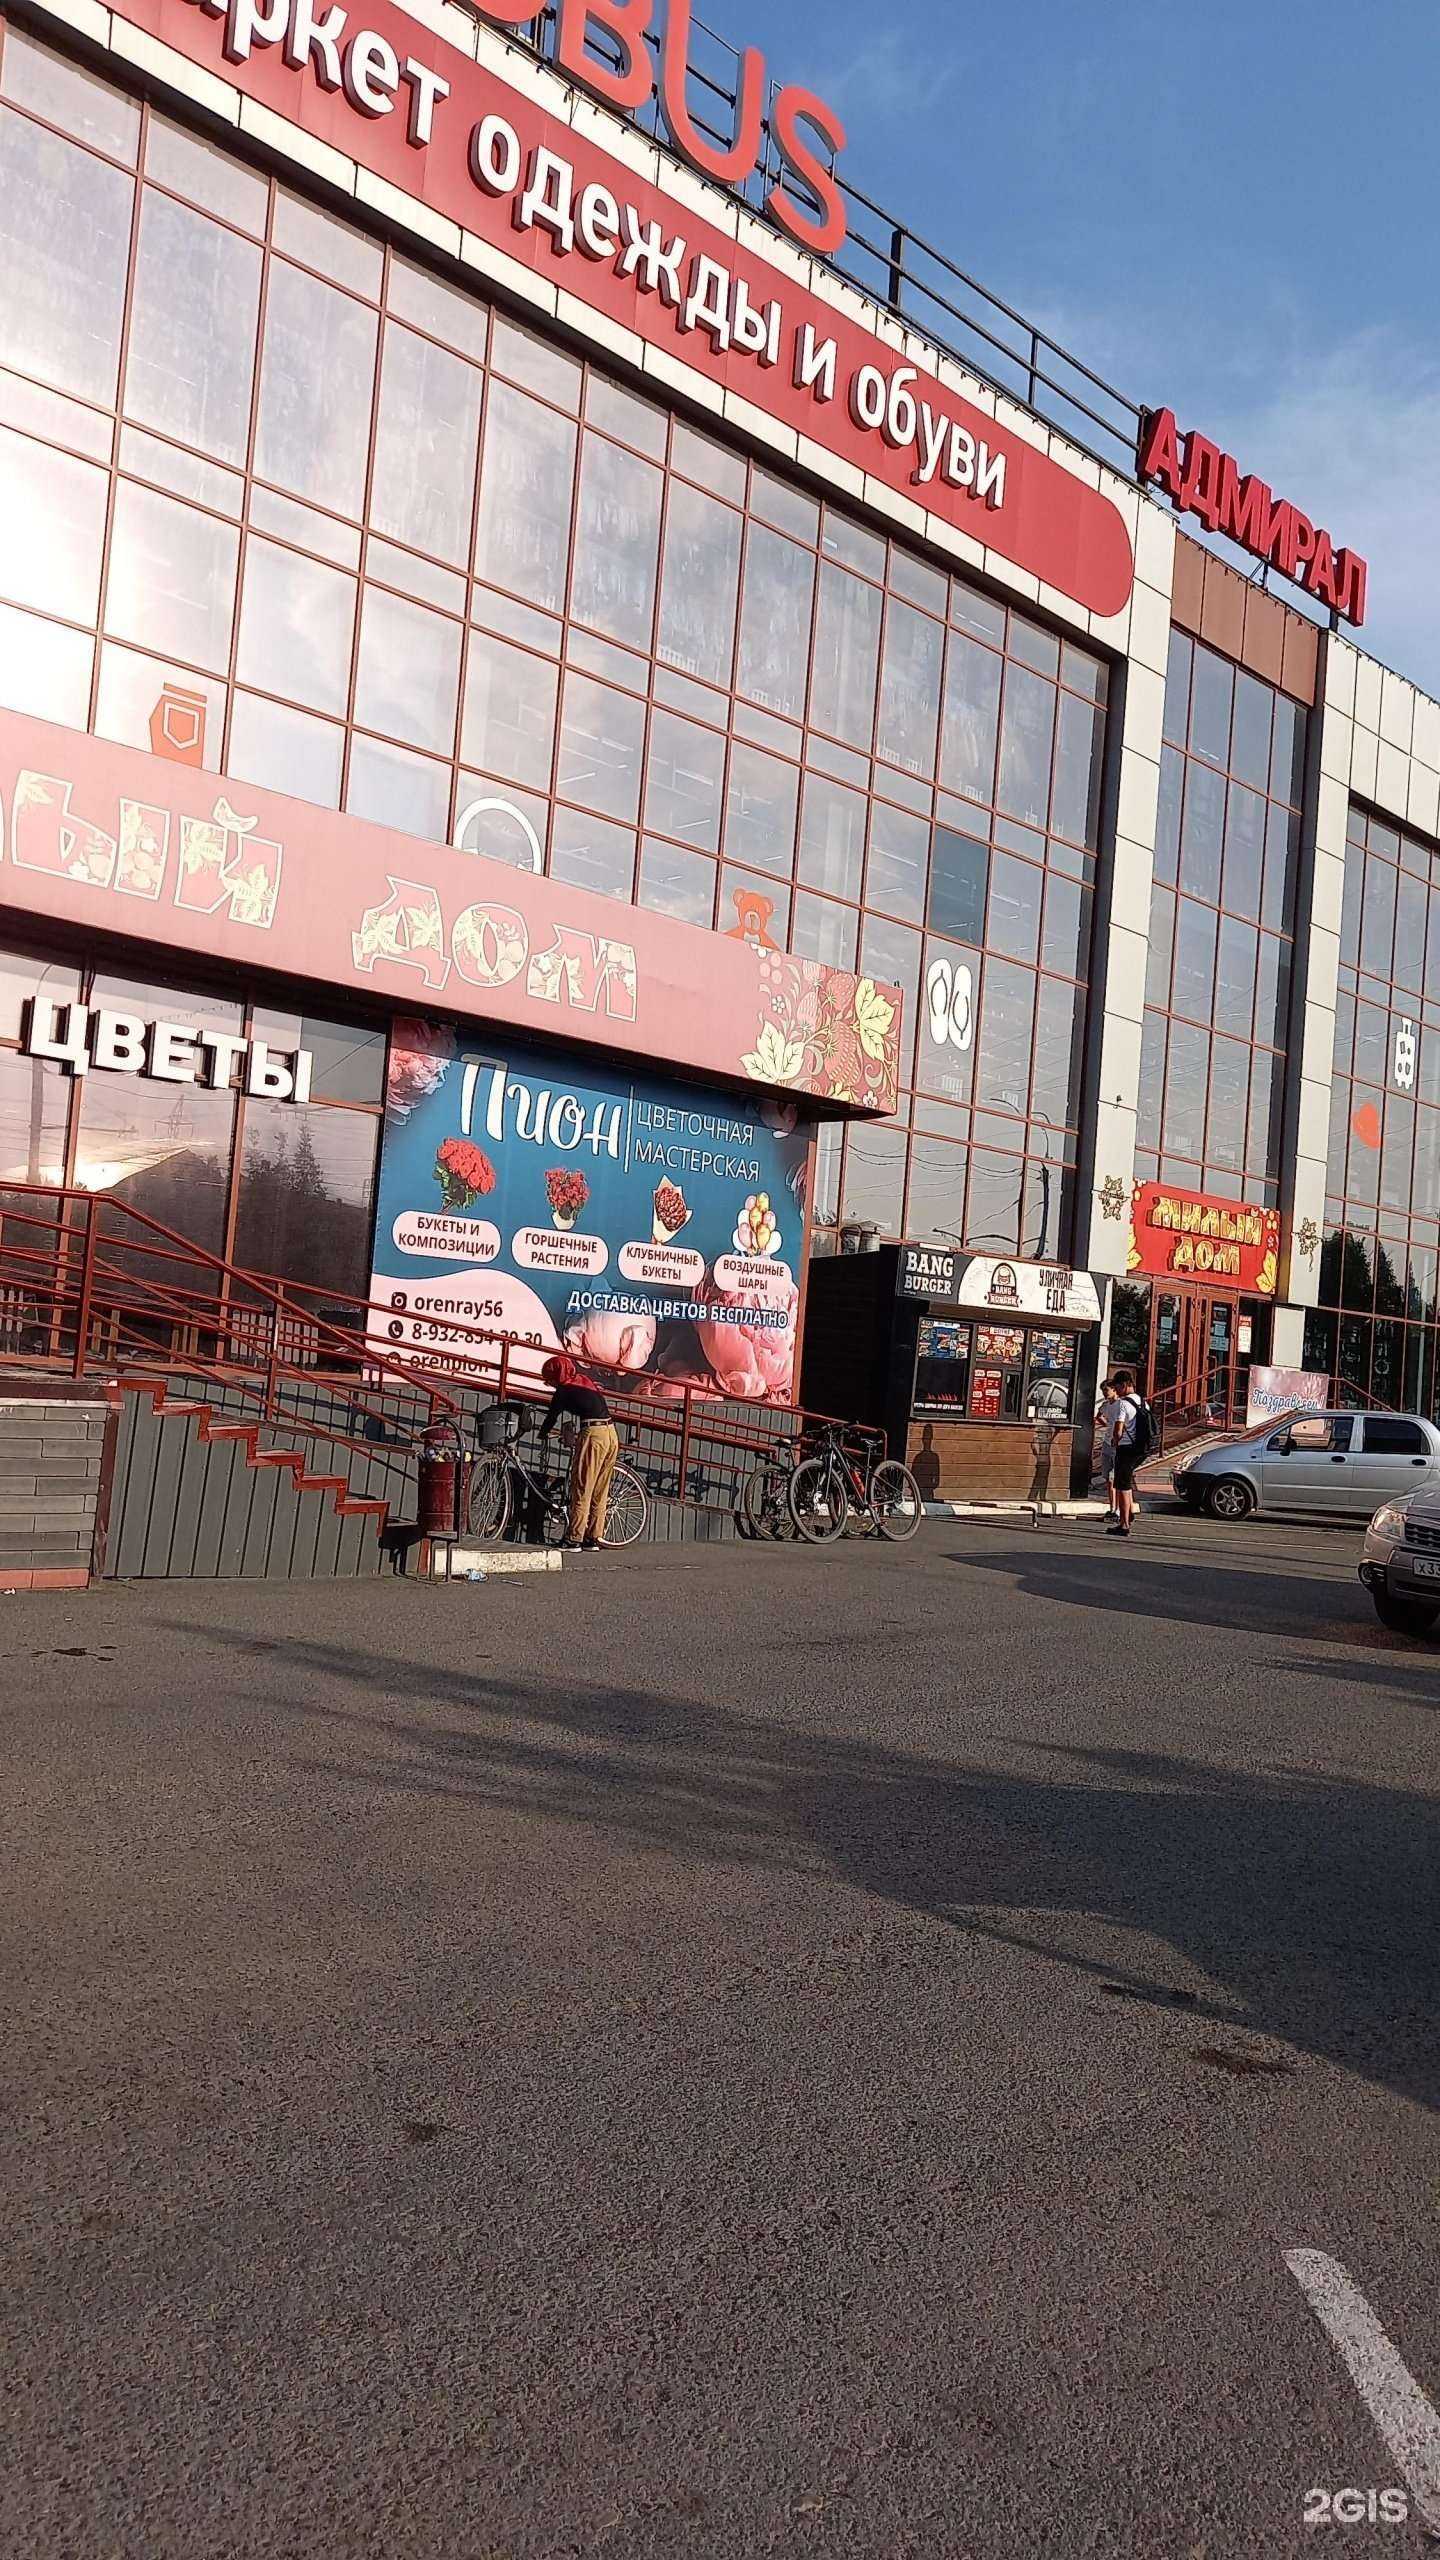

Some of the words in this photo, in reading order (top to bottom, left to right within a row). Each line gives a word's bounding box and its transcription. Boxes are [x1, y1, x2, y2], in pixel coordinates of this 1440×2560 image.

[464, 0, 848, 255] BUS
[183, 0, 450, 149] ркет
[470, 114, 781, 366] одежды
[794, 322, 838, 401] и
[849, 365, 1007, 510] обуви
[1141, 407, 1367, 627] АДМИРАЛ
[0, 768, 283, 929] ЫЙ
[351, 875, 638, 1023] ДОМ
[23, 995, 313, 1103] ЦВЕТЫ
[461, 1053, 623, 1160] Пион
[637, 1101, 755, 1146] ЦВЕТОЧНАЯ
[634, 1139, 760, 1182] МАСТЕРСКАЯ
[417, 1216, 467, 1234] БУКЕТЫ
[470, 1224, 480, 1237] И
[1150, 1196, 1263, 1246] МИЛЫЙ
[399, 1233, 495, 1257] КОМПОЗИЦИИ
[525, 1232, 598, 1253] ГОРШЕЧНЫЕ
[530, 1251, 589, 1269] РАСТЕНИЯ
[626, 1246, 699, 1267] КЛУБНИЧНЫЕ
[723, 1259, 785, 1277] ВОЗДУШНЫЕ
[905, 1251, 954, 1277] BANG
[1172, 1236, 1240, 1275] ДОМ
[641, 1265, 682, 1280] БУКЕТЫ
[738, 1278, 768, 1290] ШАРЫ
[904, 1275, 953, 1295] BURGER
[1039, 1268, 1073, 1291] УЛИЧНАЯ
[414, 1296, 504, 1320] orenray56
[567, 1290, 649, 1314] ДОСТАВКА
[651, 1300, 707, 1321] ЦВЕТОВ
[710, 1305, 788, 1328] БЕСПЛАТНО
[1046, 1289, 1066, 1312] ЕДА
